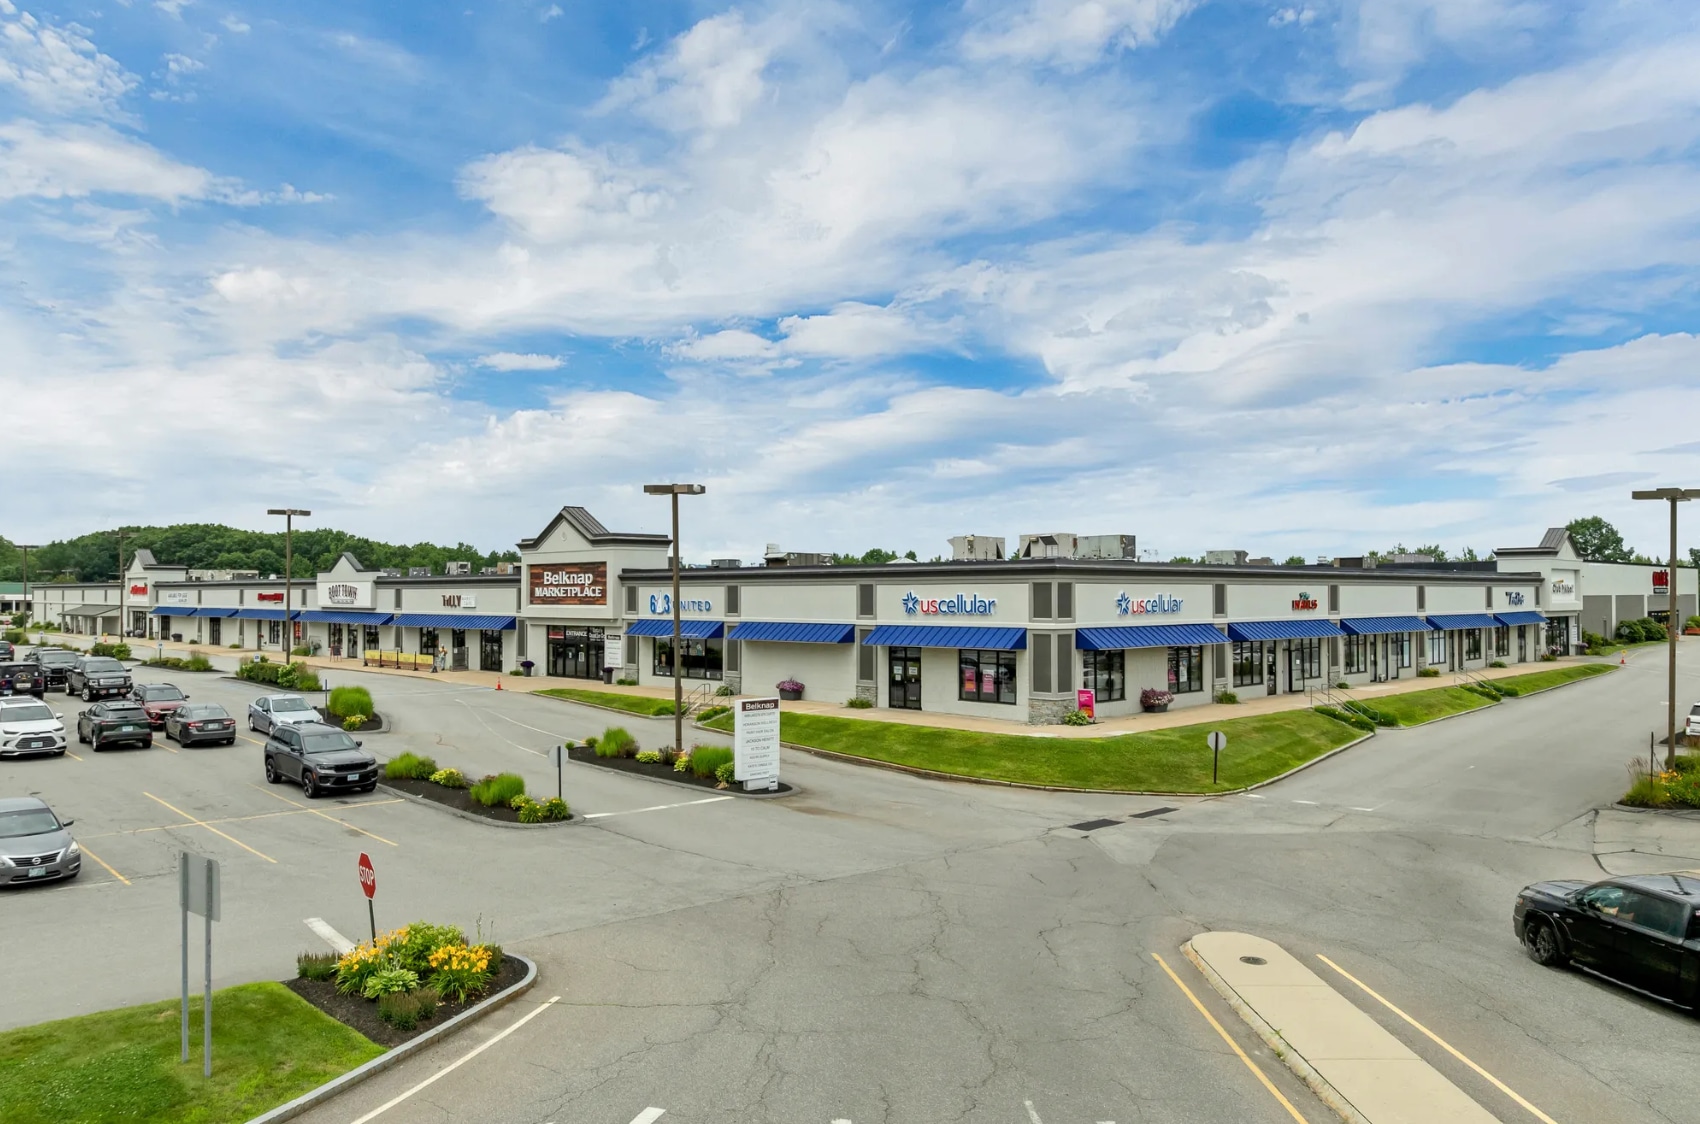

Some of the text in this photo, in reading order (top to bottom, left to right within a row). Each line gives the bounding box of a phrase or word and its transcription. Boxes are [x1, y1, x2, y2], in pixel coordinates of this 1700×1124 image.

[543, 571, 594, 587] Belknap
[534, 586, 603, 597] MARKETPLACE
[673, 600, 712, 611] NITED
[920, 594, 996, 614] uscellular
[1131, 594, 1183, 614] uscellular
[745, 702, 775, 710] Belknap
[359, 865, 374, 886] STOP
